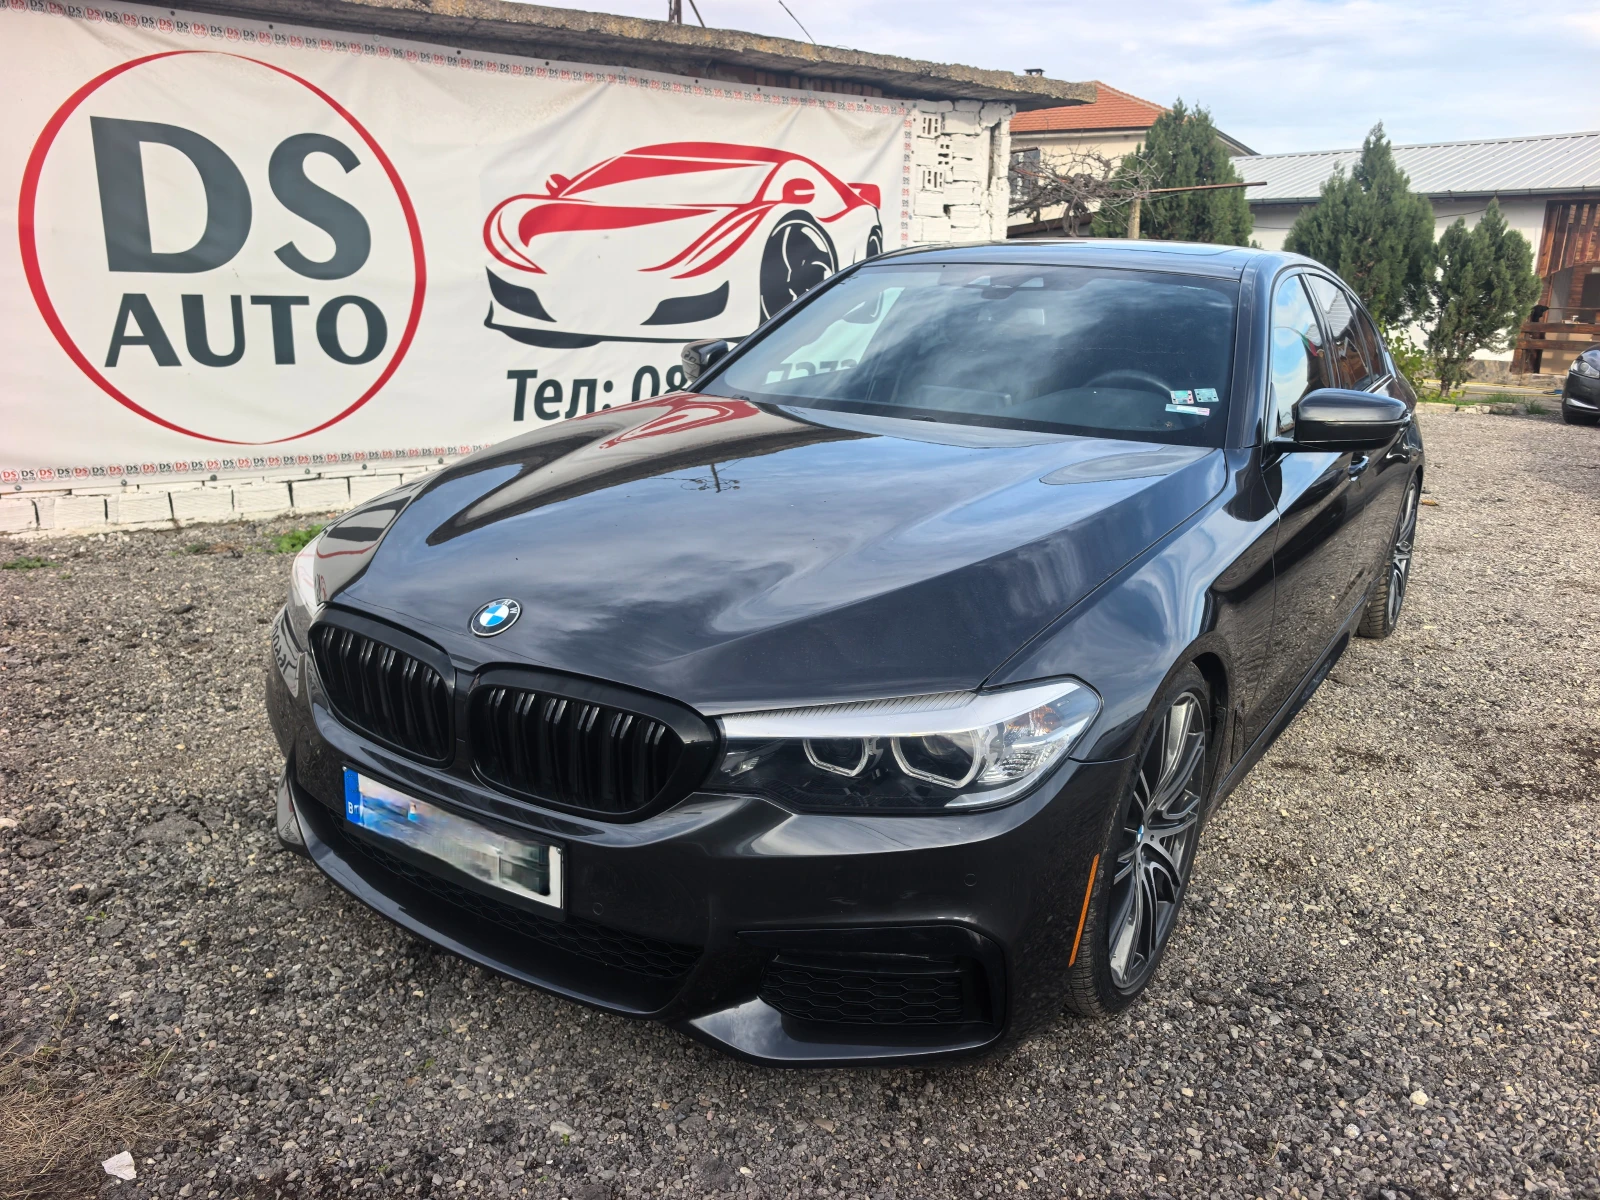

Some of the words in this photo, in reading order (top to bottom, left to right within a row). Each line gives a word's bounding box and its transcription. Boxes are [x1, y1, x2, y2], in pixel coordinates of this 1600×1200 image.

[49, 2, 62, 11] DS
[68, 6, 82, 14] DS
[87, 8, 100, 16] DS
[105, 11, 118, 19] DS
[123, 14, 136, 22] DS
[142, 16, 155, 25] DS
[176, 21, 188, 29] DS
[90, 117, 371, 281] DS
[104, 293, 388, 368] AUTO
[507, 369, 613, 422] Тел:
